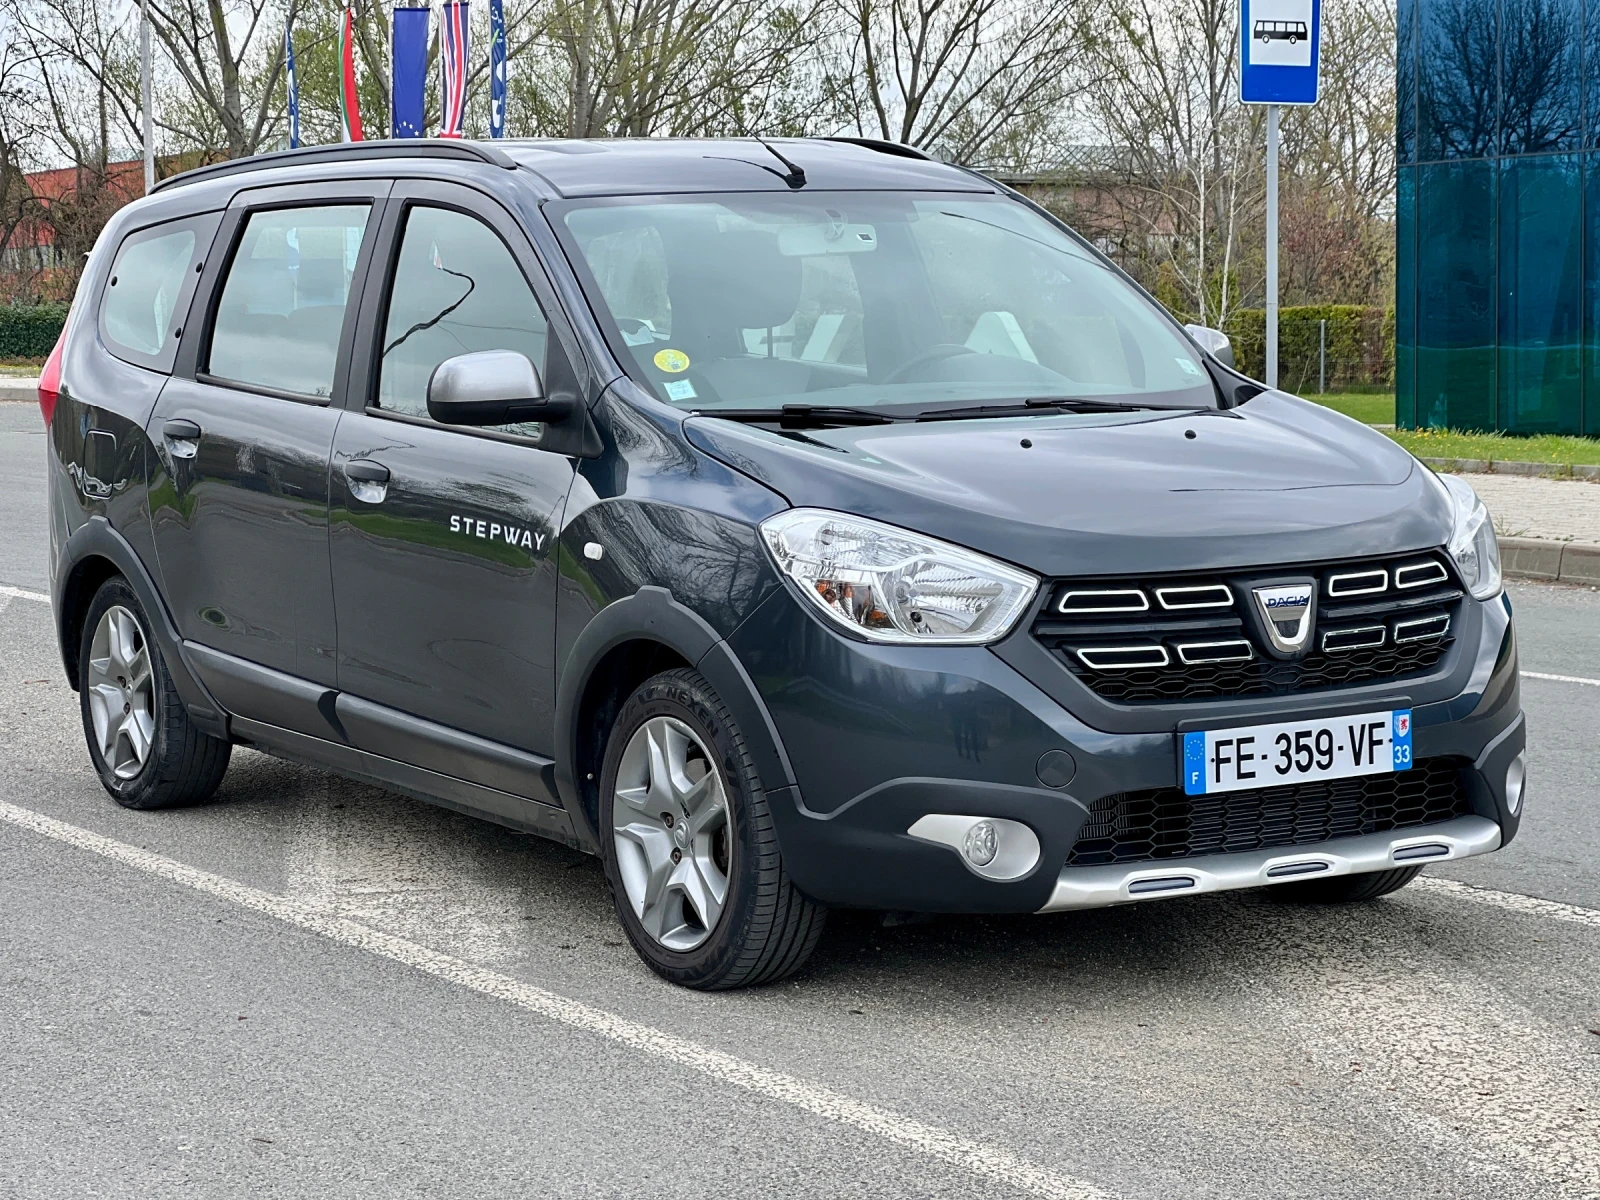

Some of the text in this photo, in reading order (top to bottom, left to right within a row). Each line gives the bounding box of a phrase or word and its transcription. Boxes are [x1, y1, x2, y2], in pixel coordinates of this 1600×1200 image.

[450, 515, 545, 551] STEPWAY
[1267, 595, 1307, 608] DACIA
[666, 687, 719, 738] NEXEN
[1214, 721, 1386, 784] FE-359-VF
[1394, 744, 1411, 764] 33
[1191, 772, 1200, 785] F
